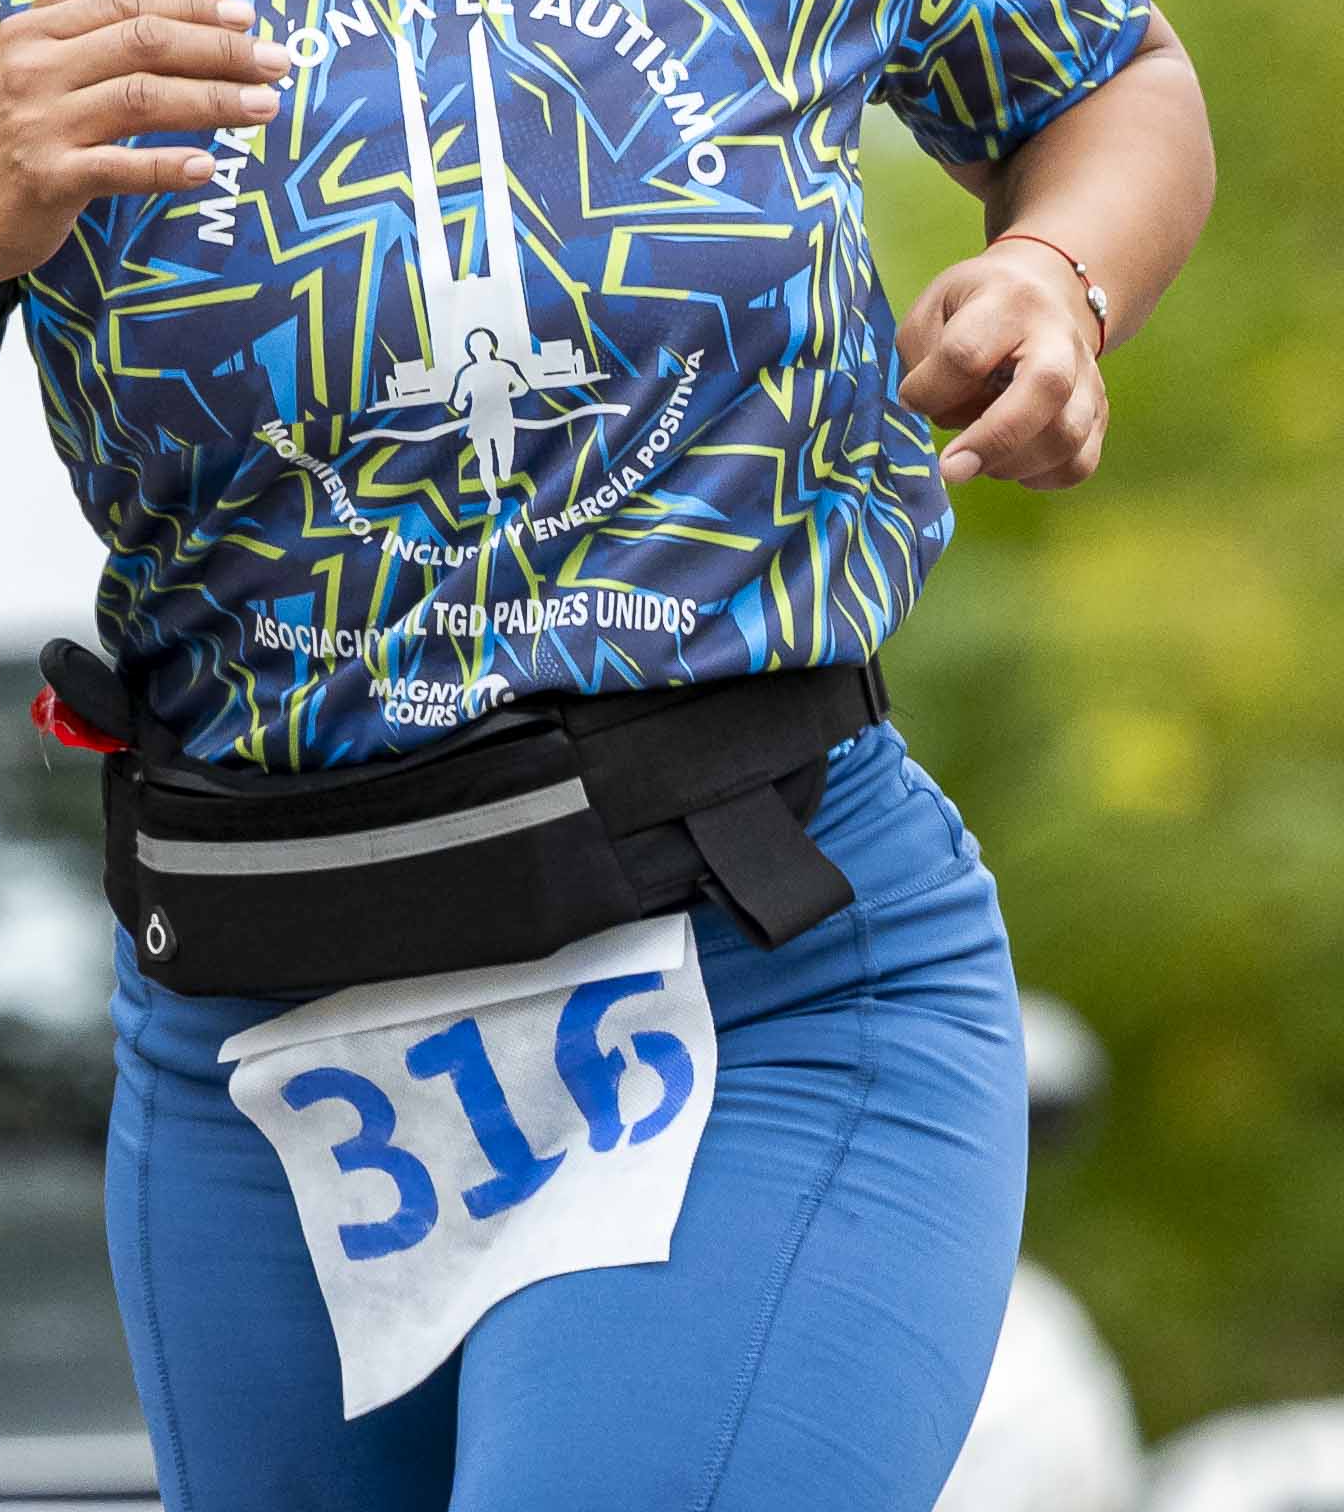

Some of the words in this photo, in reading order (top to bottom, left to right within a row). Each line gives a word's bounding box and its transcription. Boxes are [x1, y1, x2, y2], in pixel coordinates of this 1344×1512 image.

[504, 522, 525, 547] Y
[534, 465, 644, 543] ENERGÍA
[636, 348, 705, 469] POSITIVA
[433, 601, 487, 637] TGD
[494, 591, 589, 635] PADRES
[596, 590, 697, 636] UNIDOS
[368, 679, 463, 704] MAGNY
[384, 701, 457, 727] COURS
[281, 971, 694, 1262] 316
